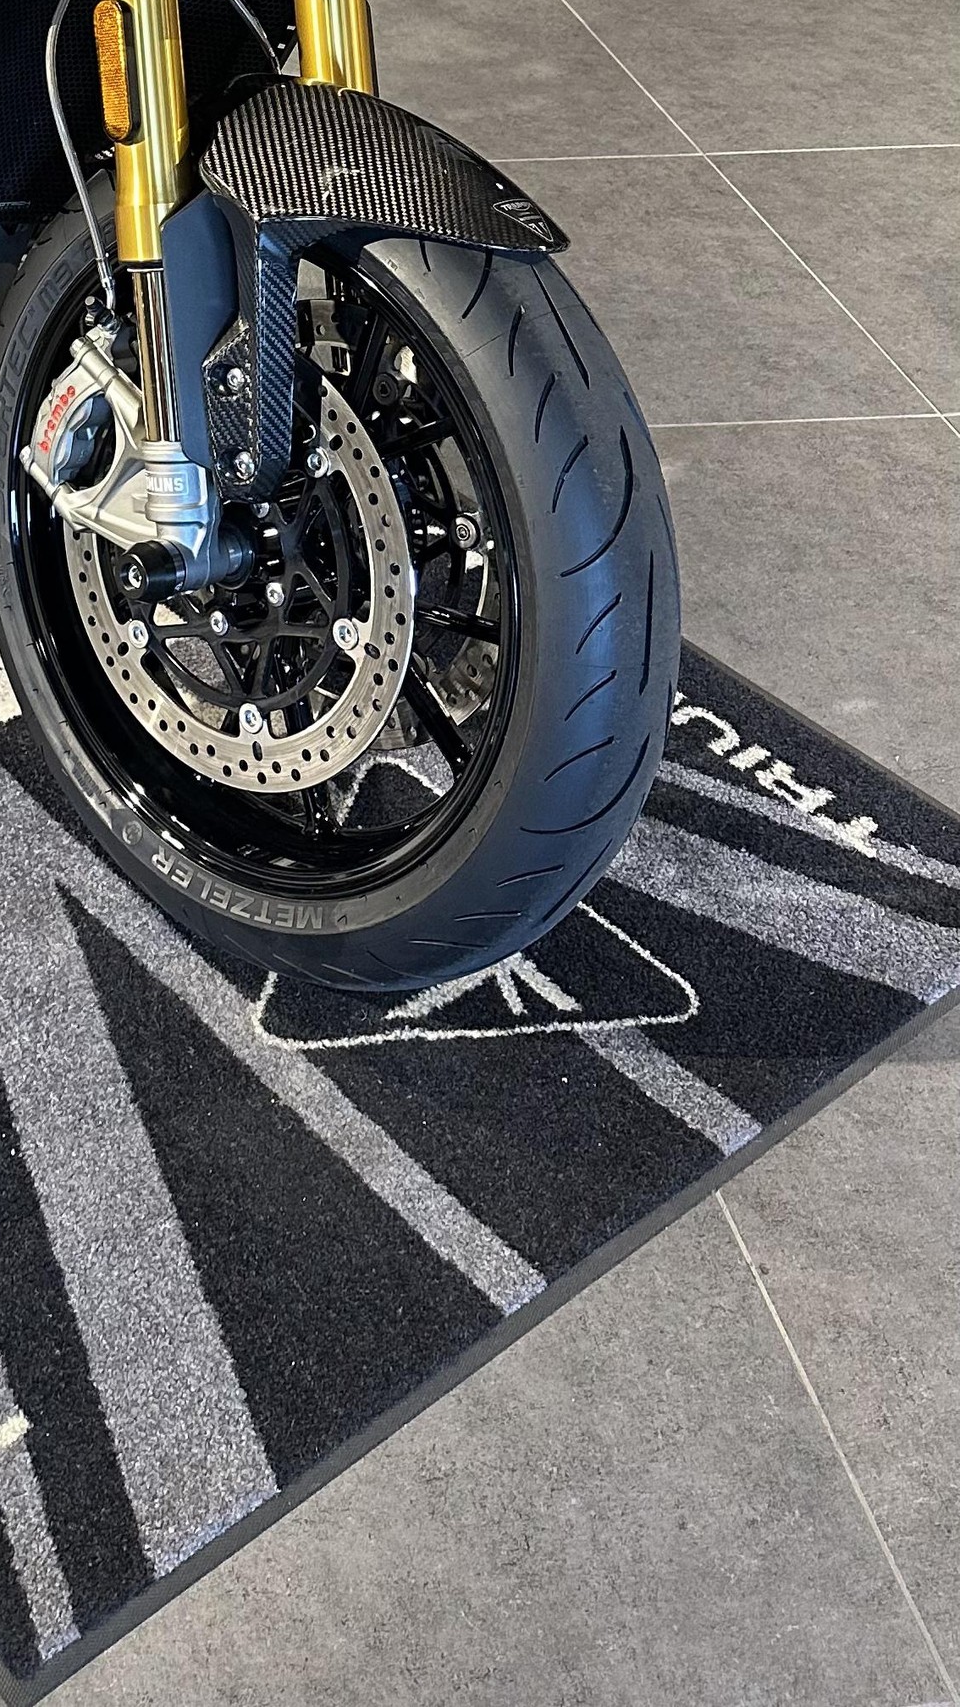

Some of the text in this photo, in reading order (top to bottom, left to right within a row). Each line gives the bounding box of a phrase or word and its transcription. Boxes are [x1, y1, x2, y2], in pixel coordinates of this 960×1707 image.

[36, 384, 76, 453] brembo
[145, 476, 184, 492] HLINS
[671, 691, 879, 859] TRIU
[151, 844, 325, 930] METZELER
